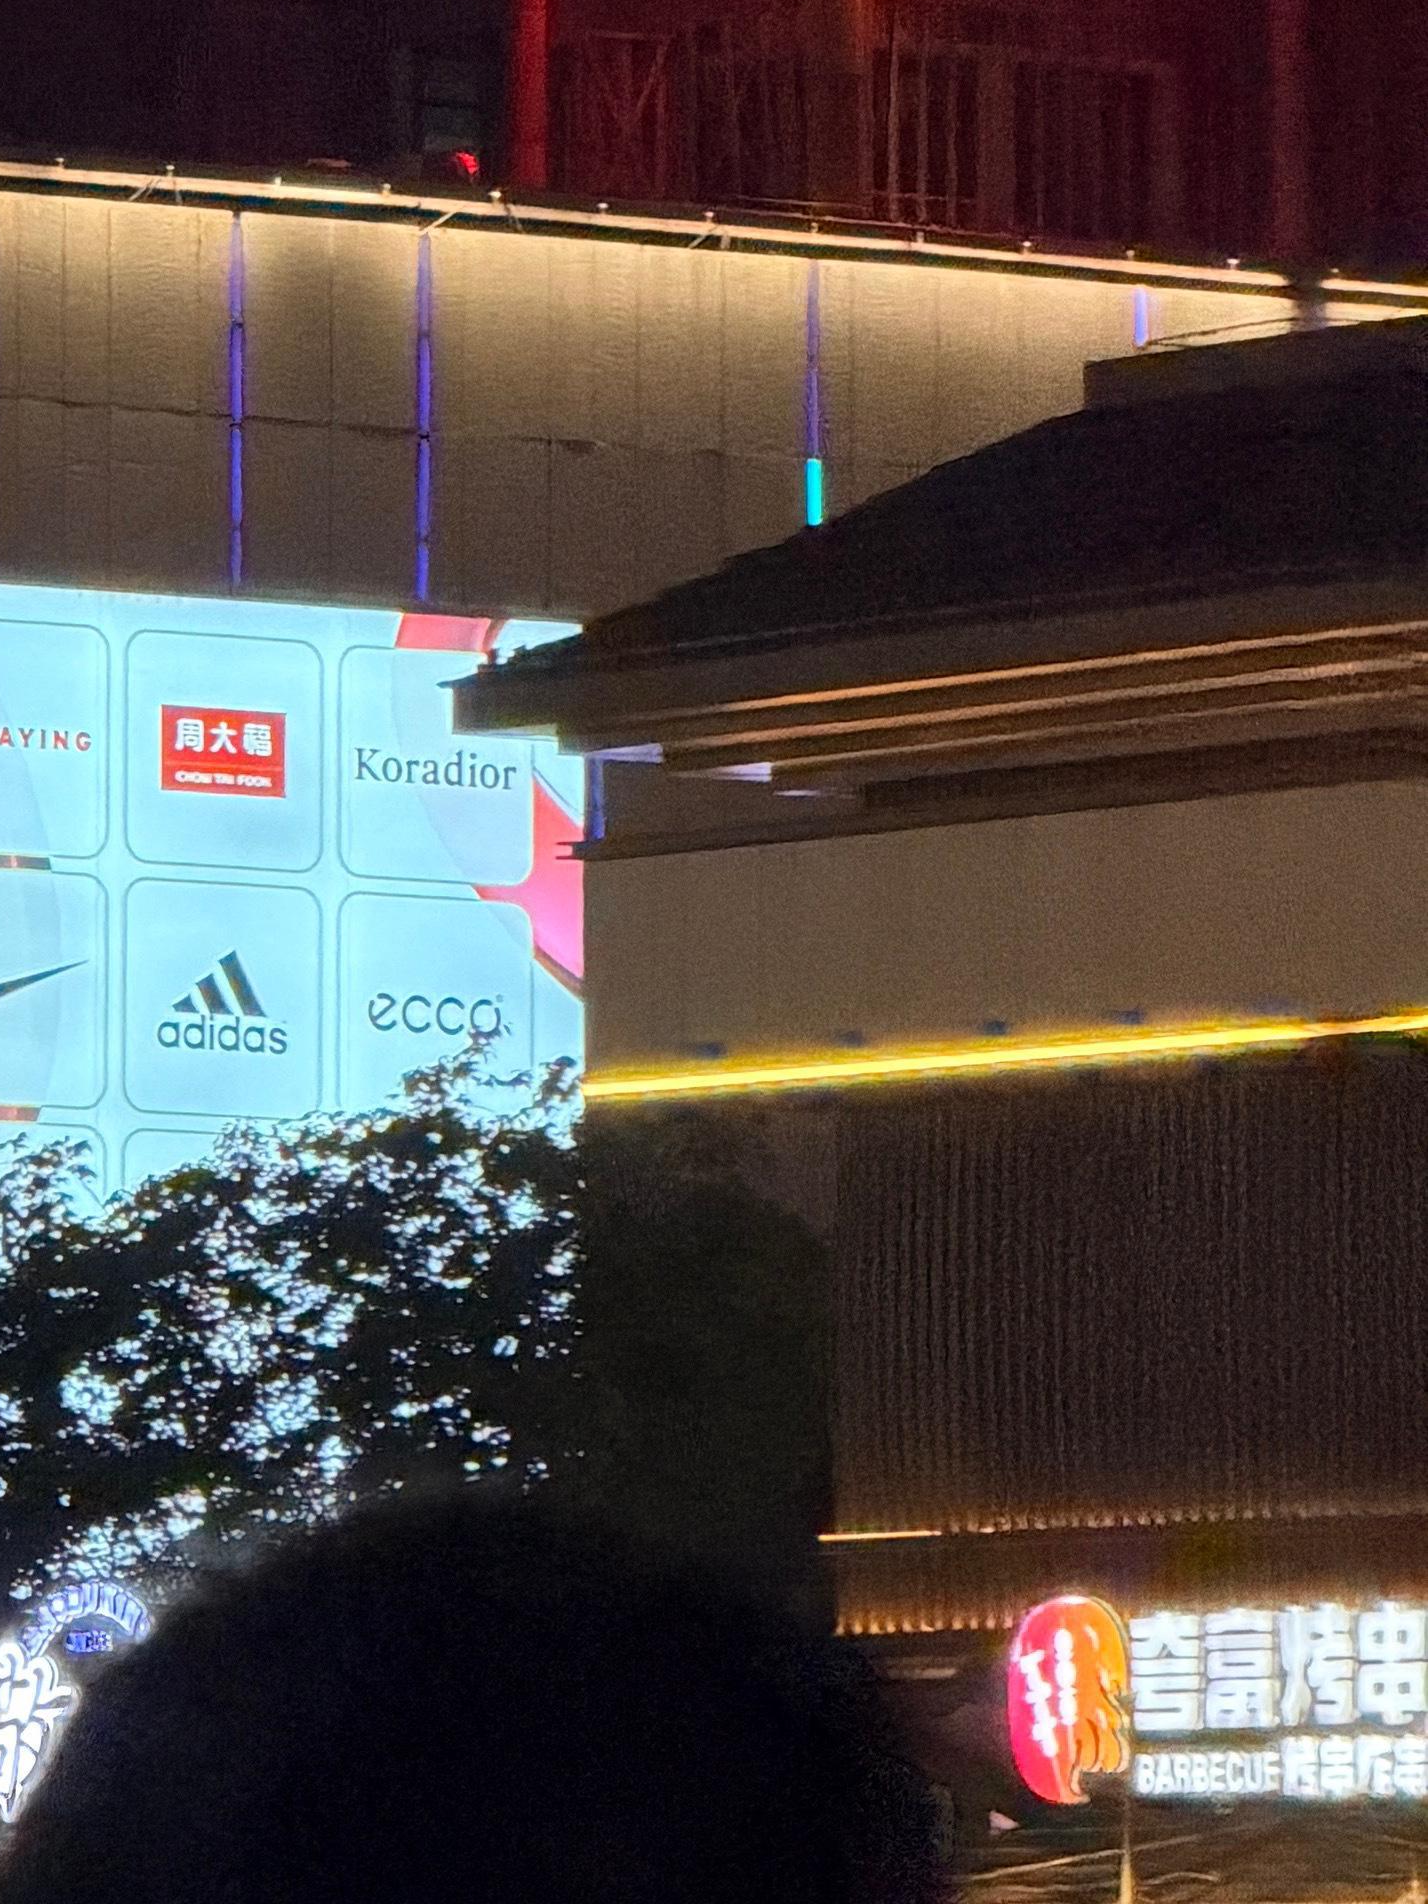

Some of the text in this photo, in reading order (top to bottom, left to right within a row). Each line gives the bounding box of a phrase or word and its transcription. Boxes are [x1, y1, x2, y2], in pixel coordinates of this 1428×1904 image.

[175, 718, 272, 757] 周大福
[354, 747, 517, 790] Koradior
[157, 1014, 287, 1054] adidas
[368, 993, 501, 1035] ecco
[1135, 1751, 1280, 1794] BARBECUE
